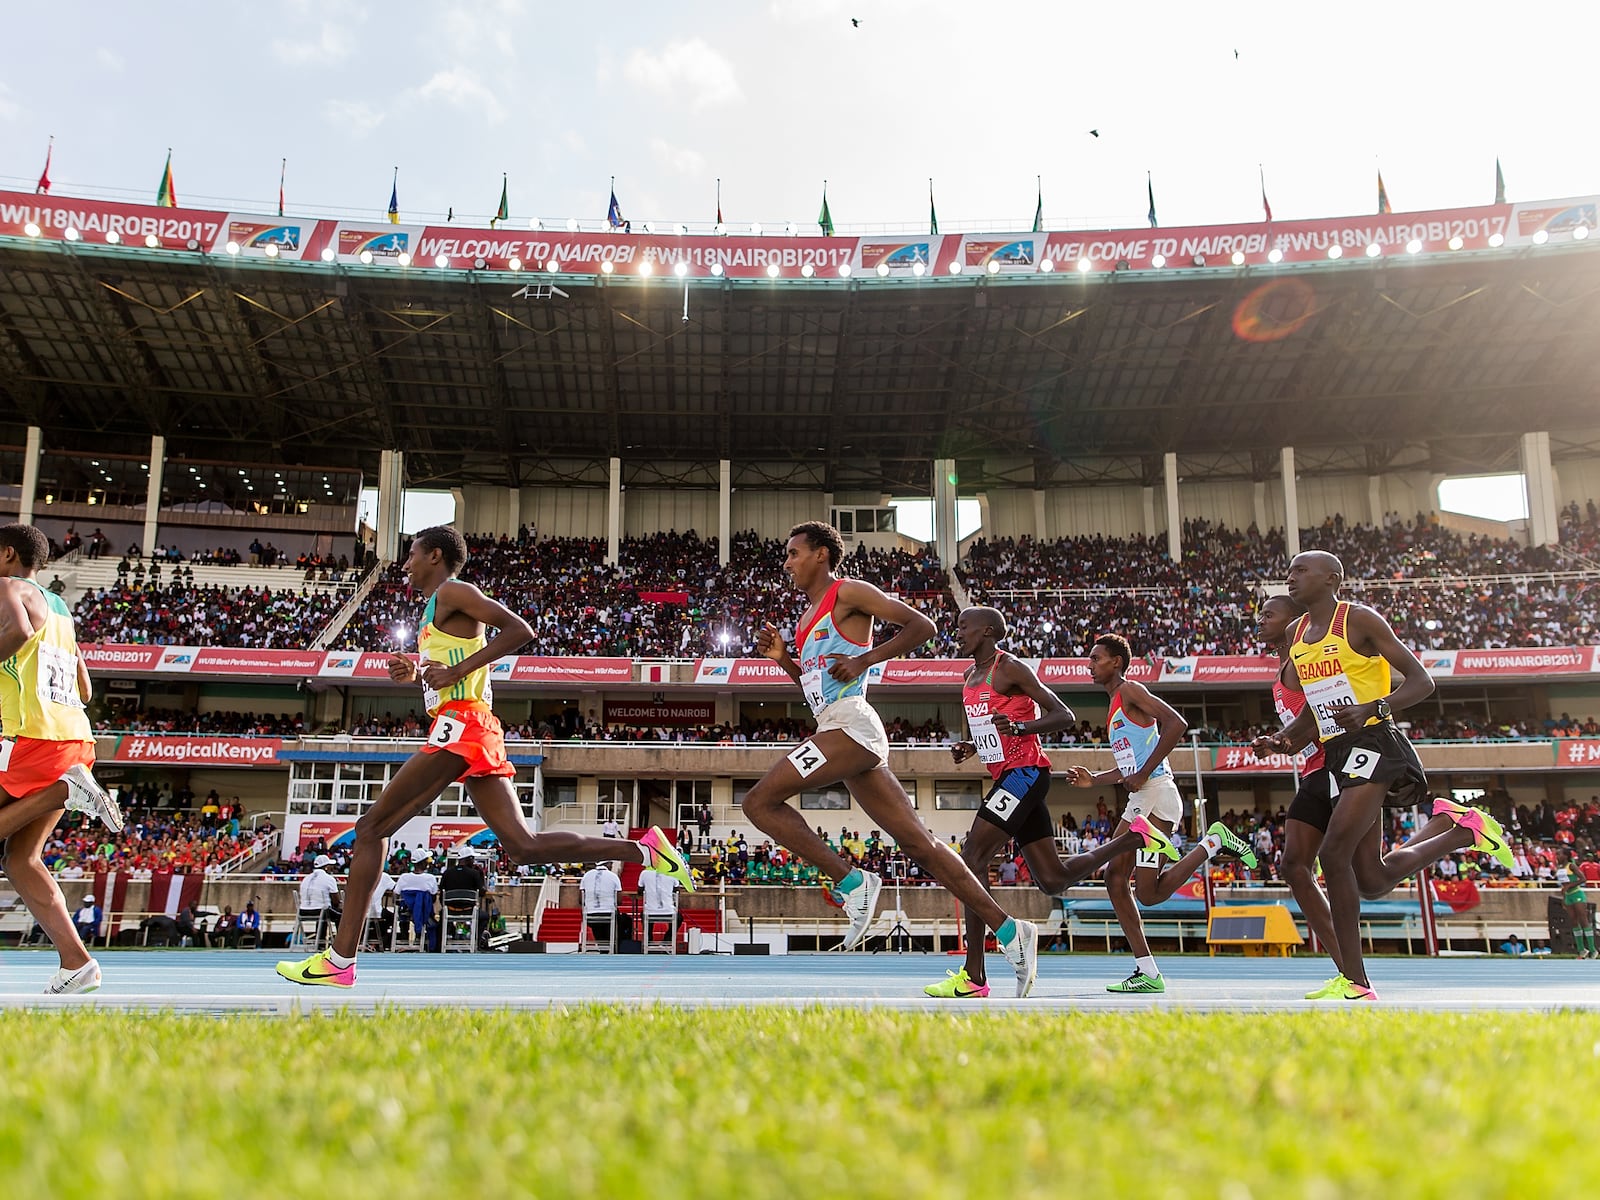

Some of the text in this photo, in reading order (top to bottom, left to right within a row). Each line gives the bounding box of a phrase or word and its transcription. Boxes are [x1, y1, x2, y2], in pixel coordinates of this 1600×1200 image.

[1275, 216, 1506, 253] #WU18NAIROBI2017
[420, 238, 637, 263] WELCOME TO NAIROBI
[642, 246, 852, 267] #WU18NAIROBI2017
[1047, 234, 1268, 262] WELCOME TO NAIROBI
[1462, 654, 1583, 669] #WU18NAIROBI2017
[608, 707, 710, 718] WELCOME TO NAIROBI
[437, 722, 454, 743] 3
[795, 746, 819, 771] 14
[1353, 754, 1369, 769] 9
[995, 795, 1011, 812] 5
